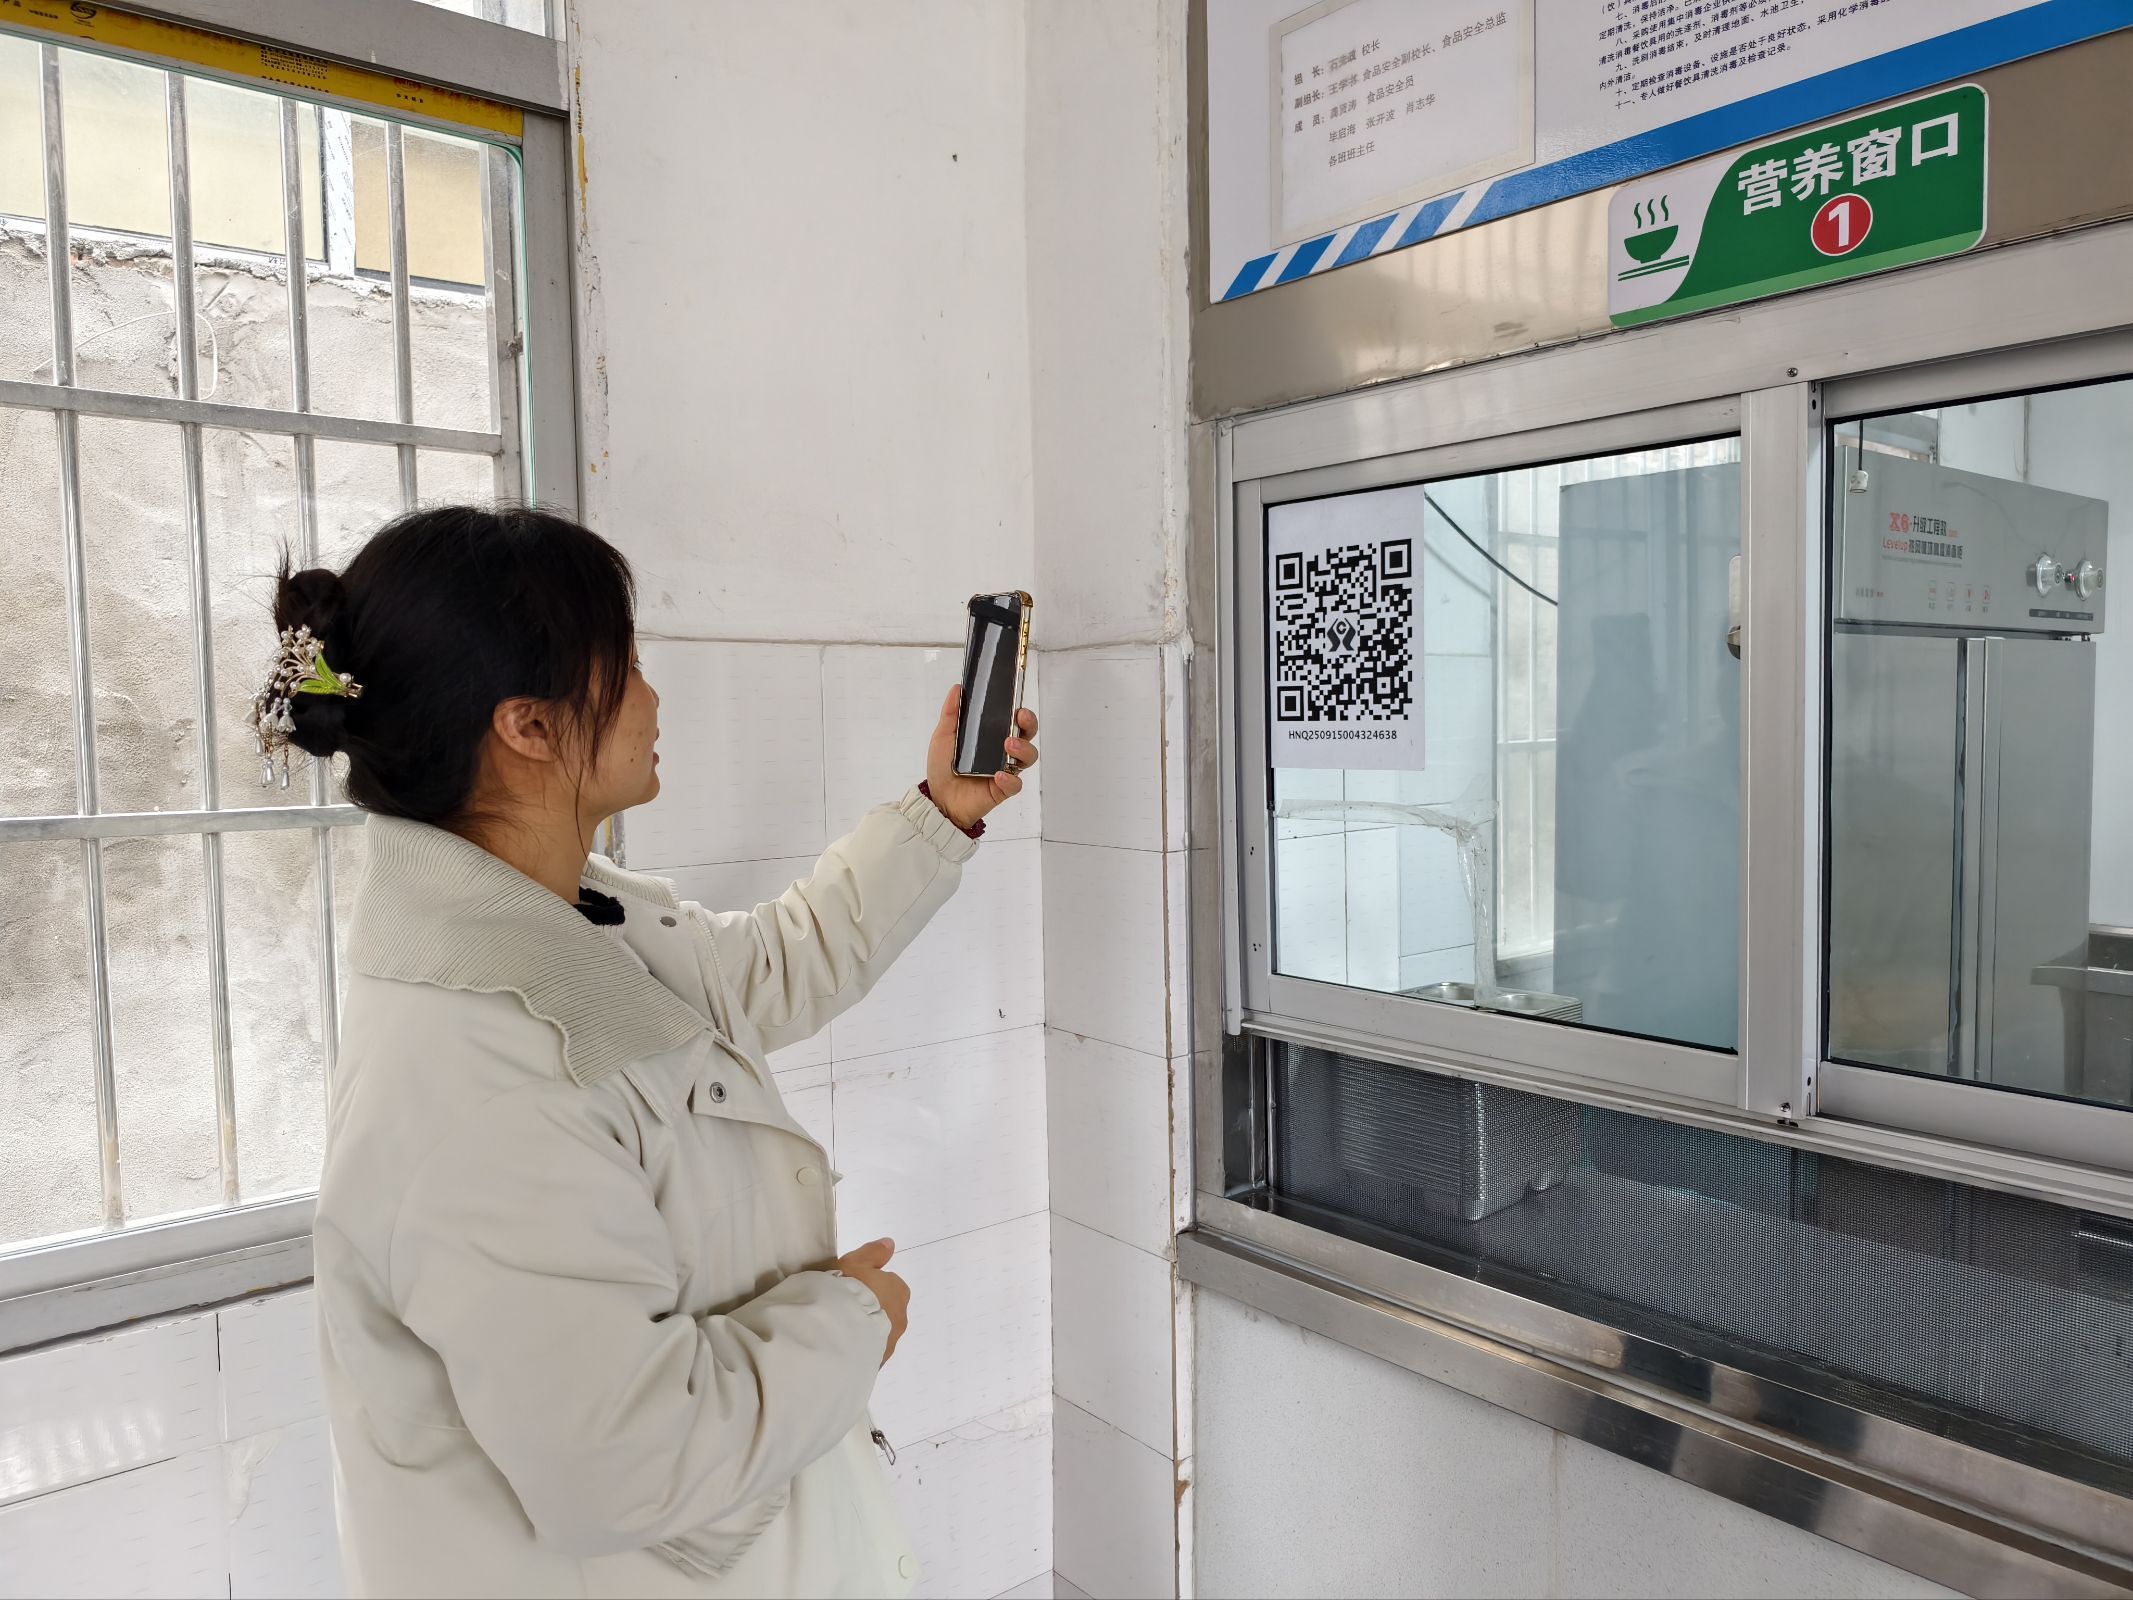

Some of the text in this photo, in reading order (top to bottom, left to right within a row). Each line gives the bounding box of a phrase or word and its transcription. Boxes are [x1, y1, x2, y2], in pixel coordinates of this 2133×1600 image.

[1737, 111, 1960, 216] 营养窗口
[1828, 201, 1850, 248] 1
[1288, 729, 1398, 741] HNQ250915004324638
